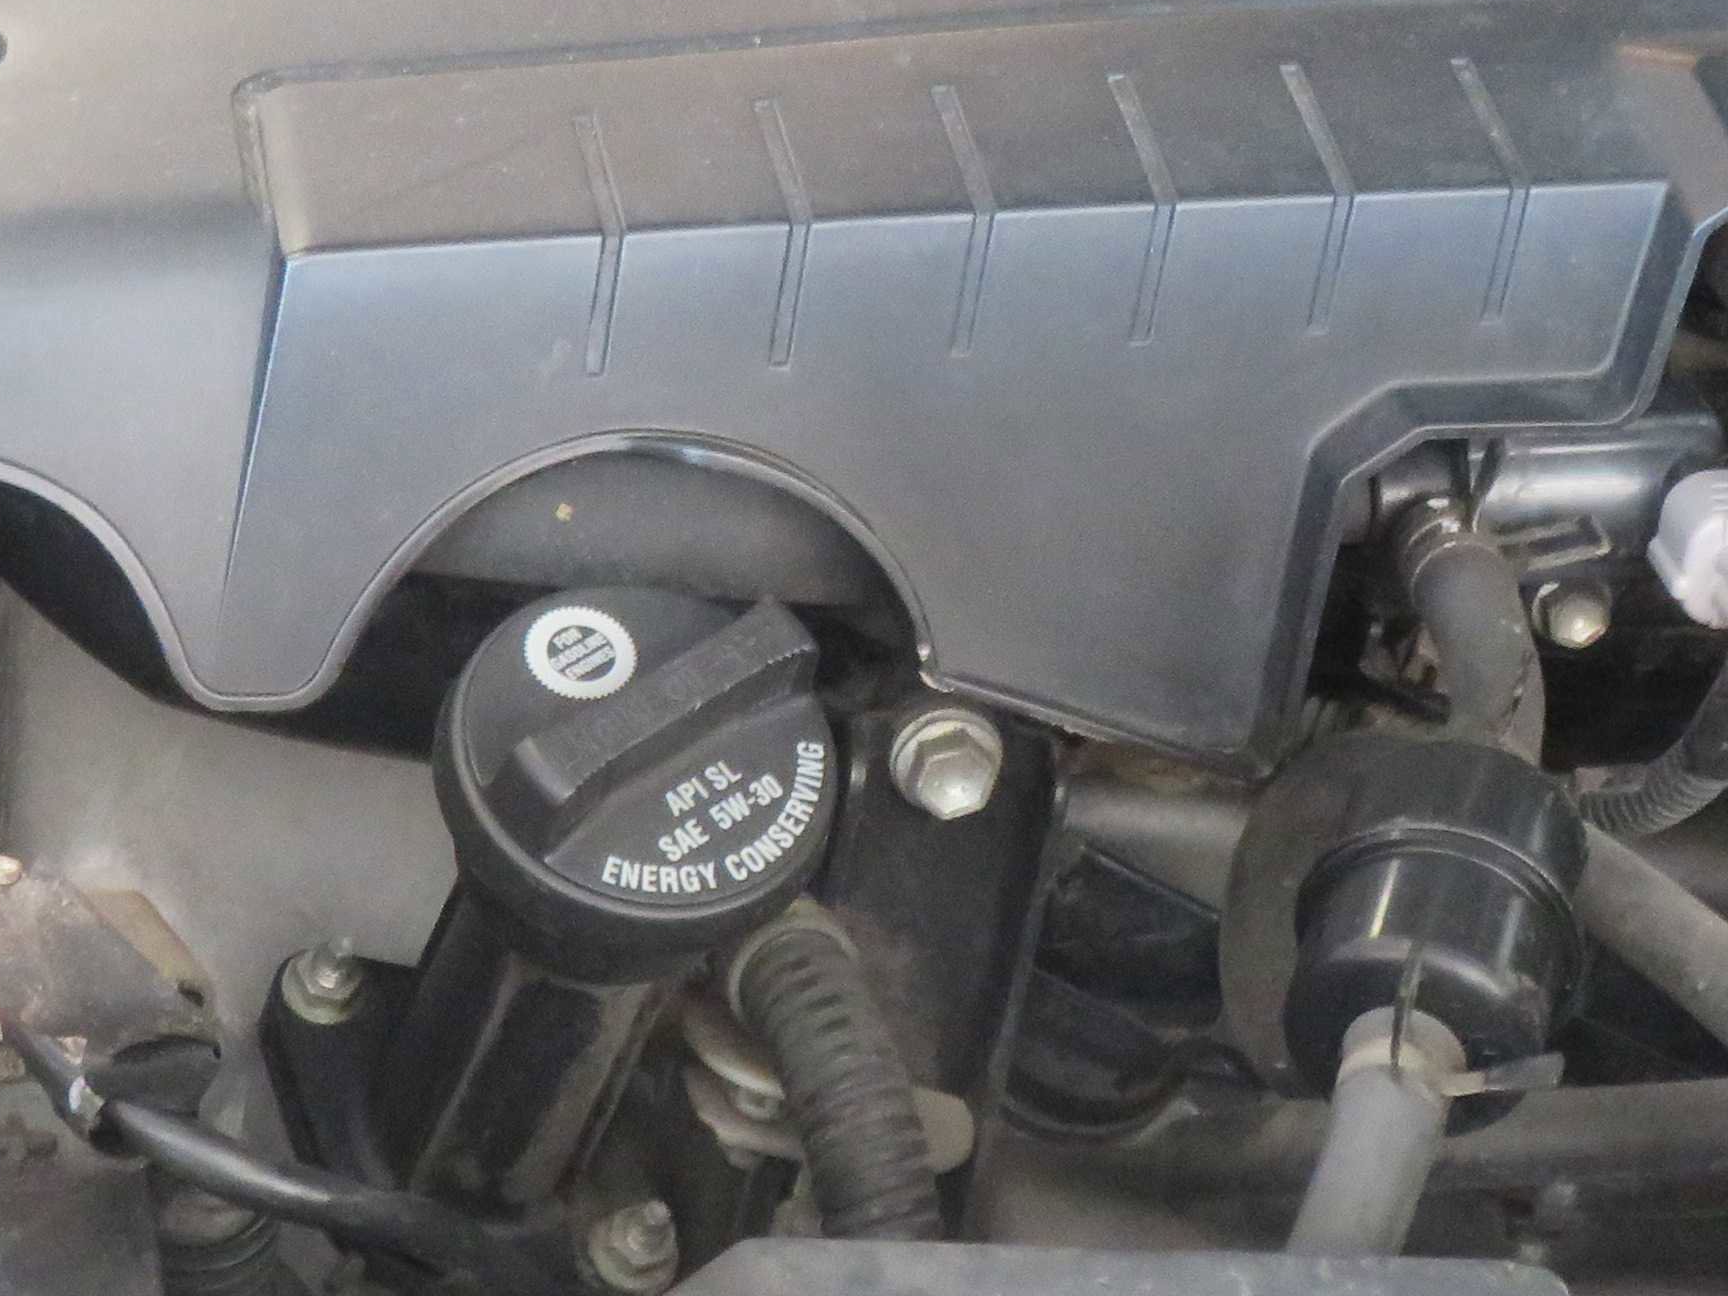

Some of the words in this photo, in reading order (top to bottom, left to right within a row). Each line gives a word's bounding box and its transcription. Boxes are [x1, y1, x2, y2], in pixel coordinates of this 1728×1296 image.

[549, 631, 609, 671] GASOLINE
[553, 627, 583, 650] FOR
[602, 855, 719, 893] ENERGY
[724, 740, 824, 881] CONSERVING
[665, 777, 709, 817] API
[704, 760, 743, 791] SL
[658, 819, 710, 862] SAE
[709, 774, 783, 830] 5W-30
